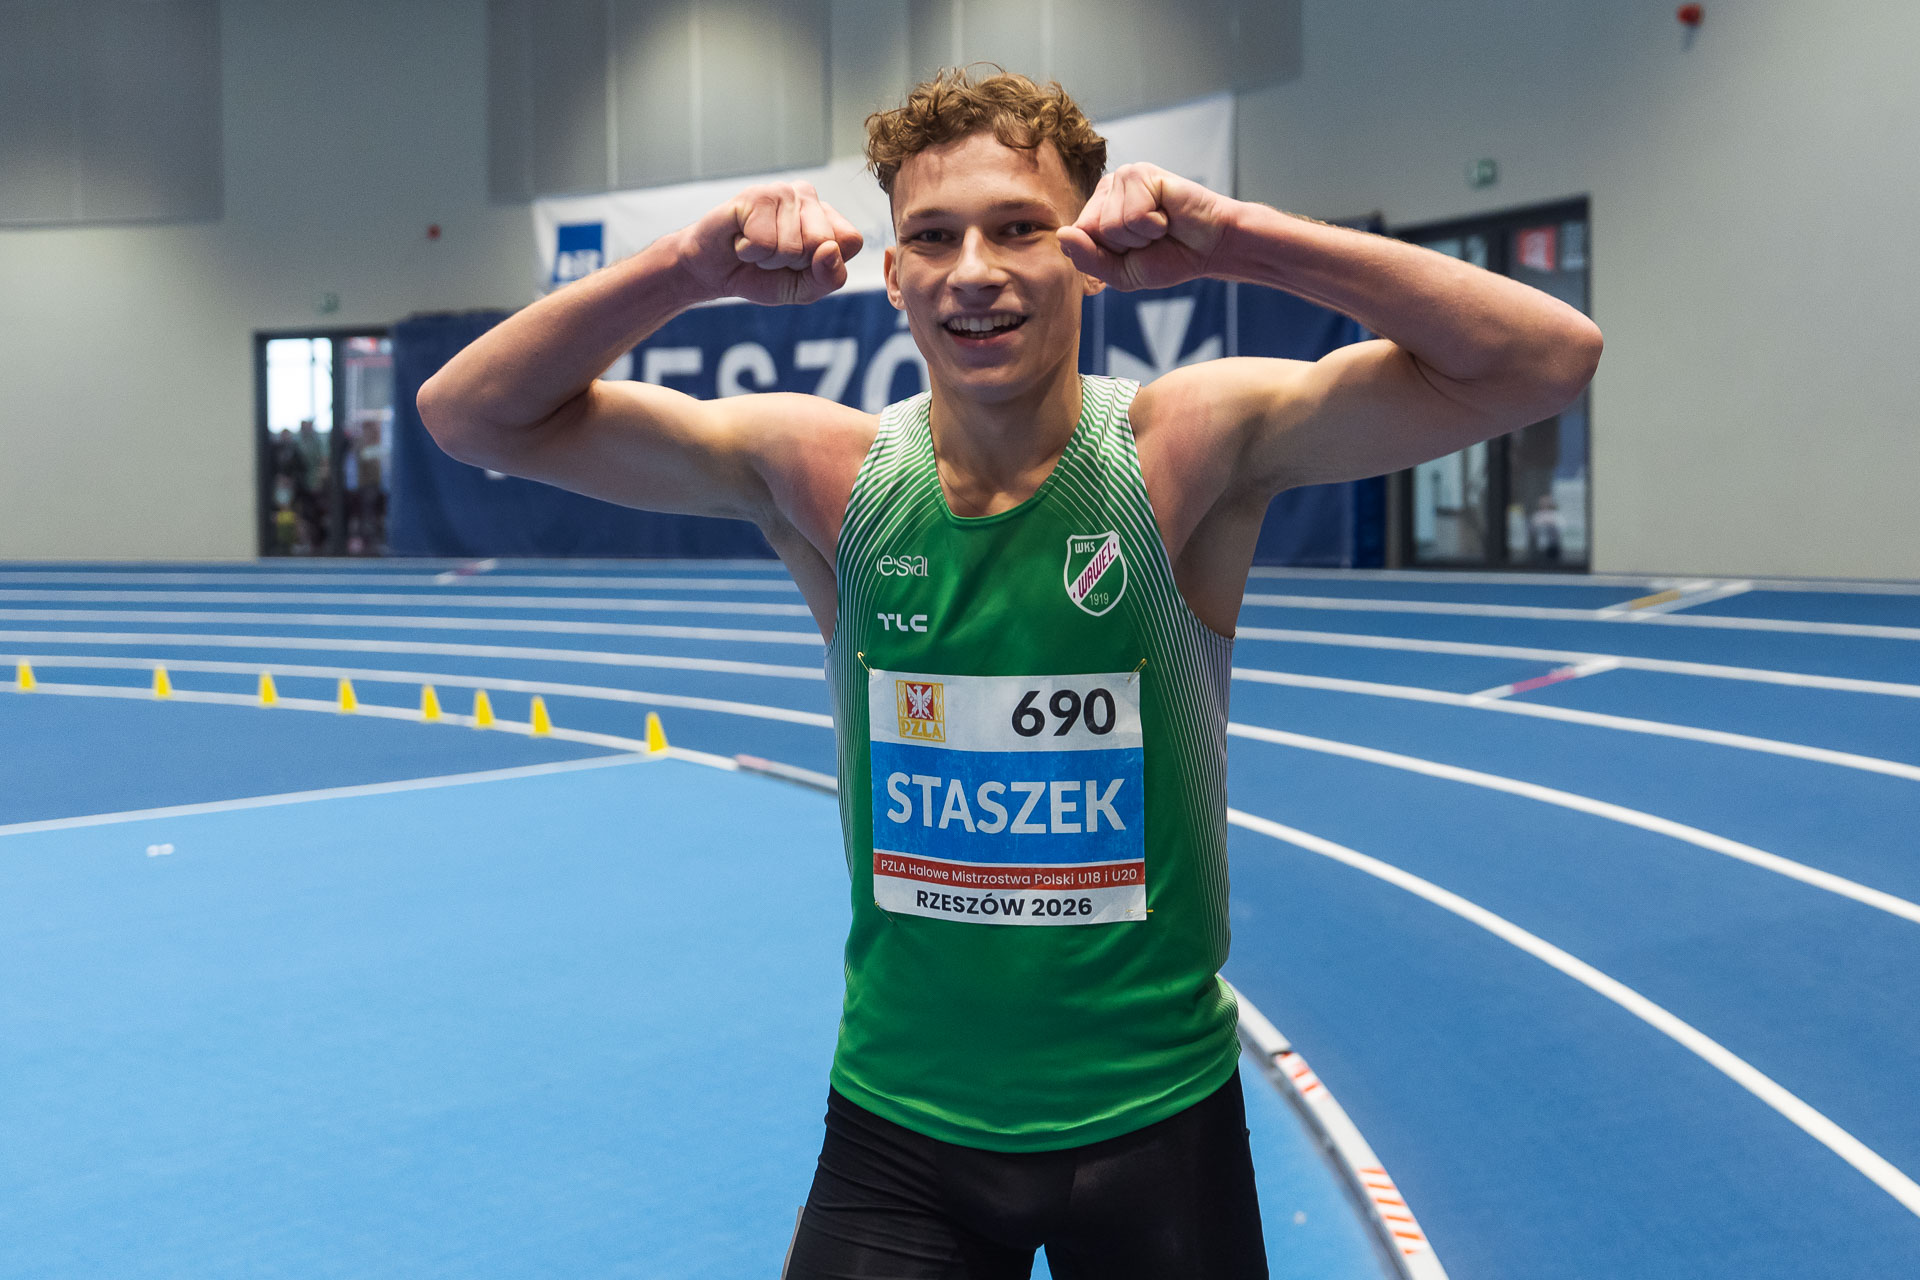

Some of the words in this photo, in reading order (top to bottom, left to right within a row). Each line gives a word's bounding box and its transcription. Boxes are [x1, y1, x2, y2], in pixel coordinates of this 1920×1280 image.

[1075, 541, 1096, 554] WKS
[1078, 541, 1115, 599] WAWEL
[1089, 592, 1109, 606] 1919
[877, 612, 928, 633] TLC
[1011, 687, 1117, 738] 690
[901, 719, 943, 739] PZLA
[886, 771, 1127, 835] STASZEK
[881, 859, 906, 874] PZLA
[909, 863, 949, 880] Halowe
[952, 870, 1031, 885] Mistrzostwa
[1034, 872, 1074, 885] Polski
[1078, 871, 1101, 884] U18
[1104, 870, 1108, 882] i
[1112, 868, 1137, 882] U20
[916, 889, 1026, 916] RZESZÓW
[1031, 897, 1093, 916] 2026
